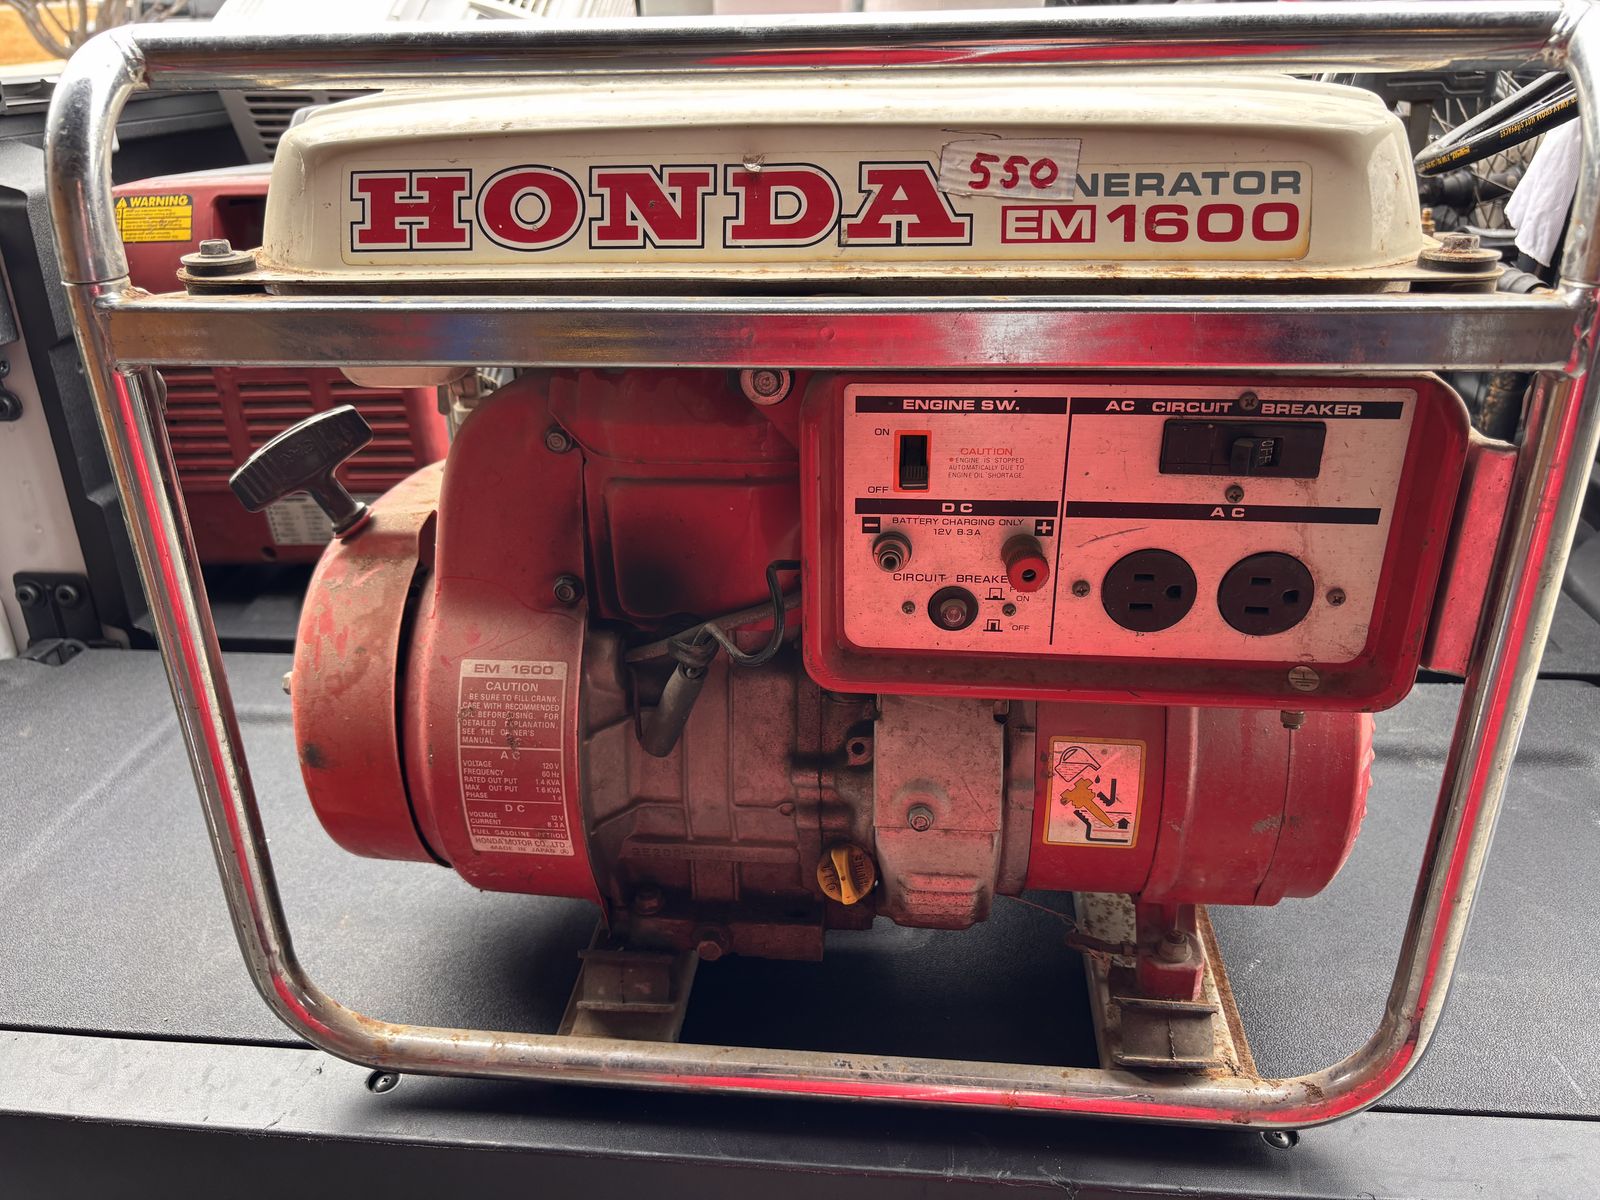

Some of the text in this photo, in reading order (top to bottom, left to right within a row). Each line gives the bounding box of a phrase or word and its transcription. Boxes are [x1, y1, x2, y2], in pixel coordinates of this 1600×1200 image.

[968, 152, 1059, 190] 550
[1075, 170, 1301, 198] NERATOR
[129, 194, 189, 208] WARNING
[350, 161, 974, 252] HONDA
[1004, 202, 1300, 243] EM 1600
[902, 399, 1020, 411] ENGINE SW.
[1105, 400, 1362, 416] AC CIRCUIT BREAKER
[874, 427, 890, 436] ON
[960, 447, 1013, 456] CAUTION
[1258, 439, 1275, 464] OFF
[948, 471, 972, 479] ENGINE
[973, 471, 984, 479] OIL
[867, 485, 889, 494] OFF
[892, 516, 1025, 527] BATTERY CHARGING ONLY
[933, 527, 952, 536] 12V
[893, 572, 1009, 584] CIRCUIT BREAKE
[474, 663, 554, 675] EM 1600
[486, 681, 539, 692] CAUTION
[469, 692, 479, 701] BE
[480, 693, 501, 701] SURE
[502, 694, 512, 702] TO
[514, 694, 529, 702] FILL
[462, 701, 560, 712] CASE WITH RECOMMENDED
[477, 710, 506, 719] BEFORE
[544, 712, 559, 721] FOR
[462, 718, 497, 727] DETAILED
[461, 727, 476, 736] SEE
[480, 728, 495, 736] THE
[463, 759, 492, 768] VOLTAGE
[463, 767, 505, 776] FREQUENCY
[463, 775, 486, 784] RATED
[487, 776, 502, 784] OUT
[504, 777, 518, 785] PUT
[504, 785, 519, 793] PUT
[465, 791, 488, 799] PHASE
[469, 811, 498, 819] VOLTAGE
[494, 829, 531, 838] GASOLINE
